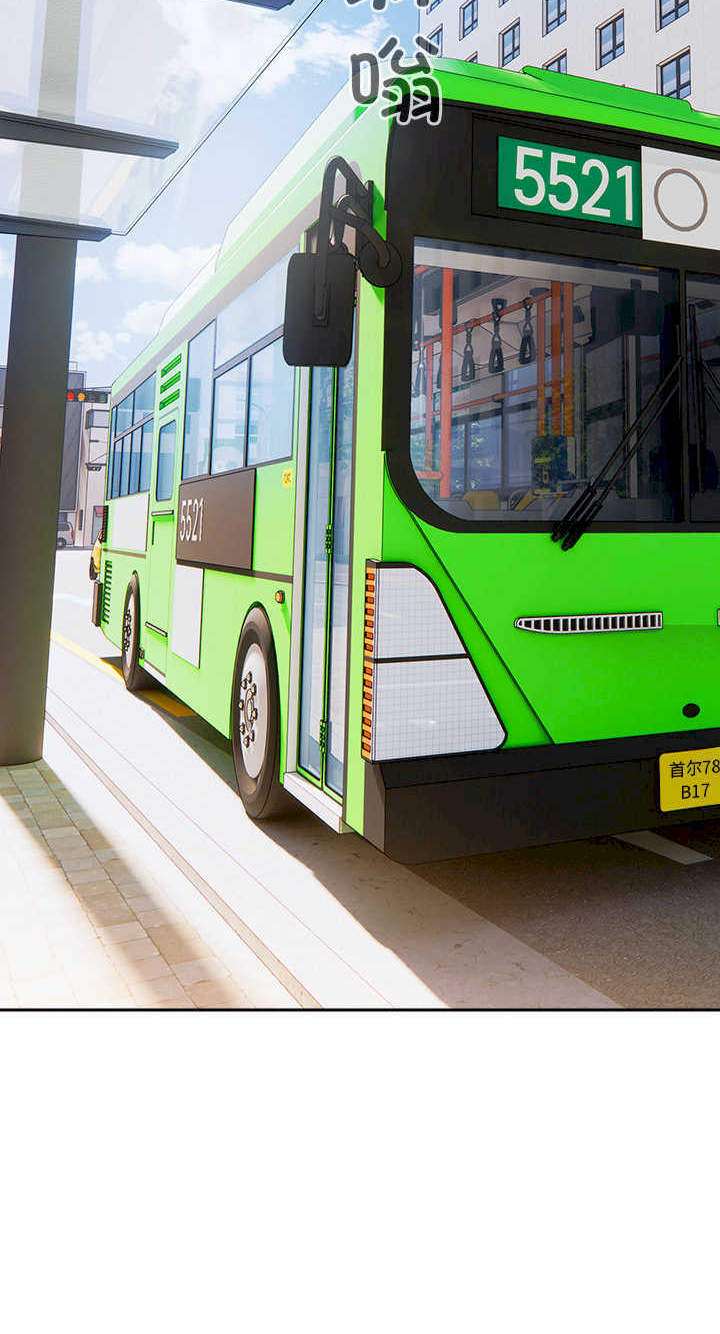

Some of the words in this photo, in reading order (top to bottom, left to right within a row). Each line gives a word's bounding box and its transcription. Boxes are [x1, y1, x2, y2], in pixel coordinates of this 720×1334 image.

[514, 145, 633, 221] 5521
[180, 498, 204, 542] 5521
[669, 759, 720, 779] 首尔78
[681, 783, 710, 800] B17
